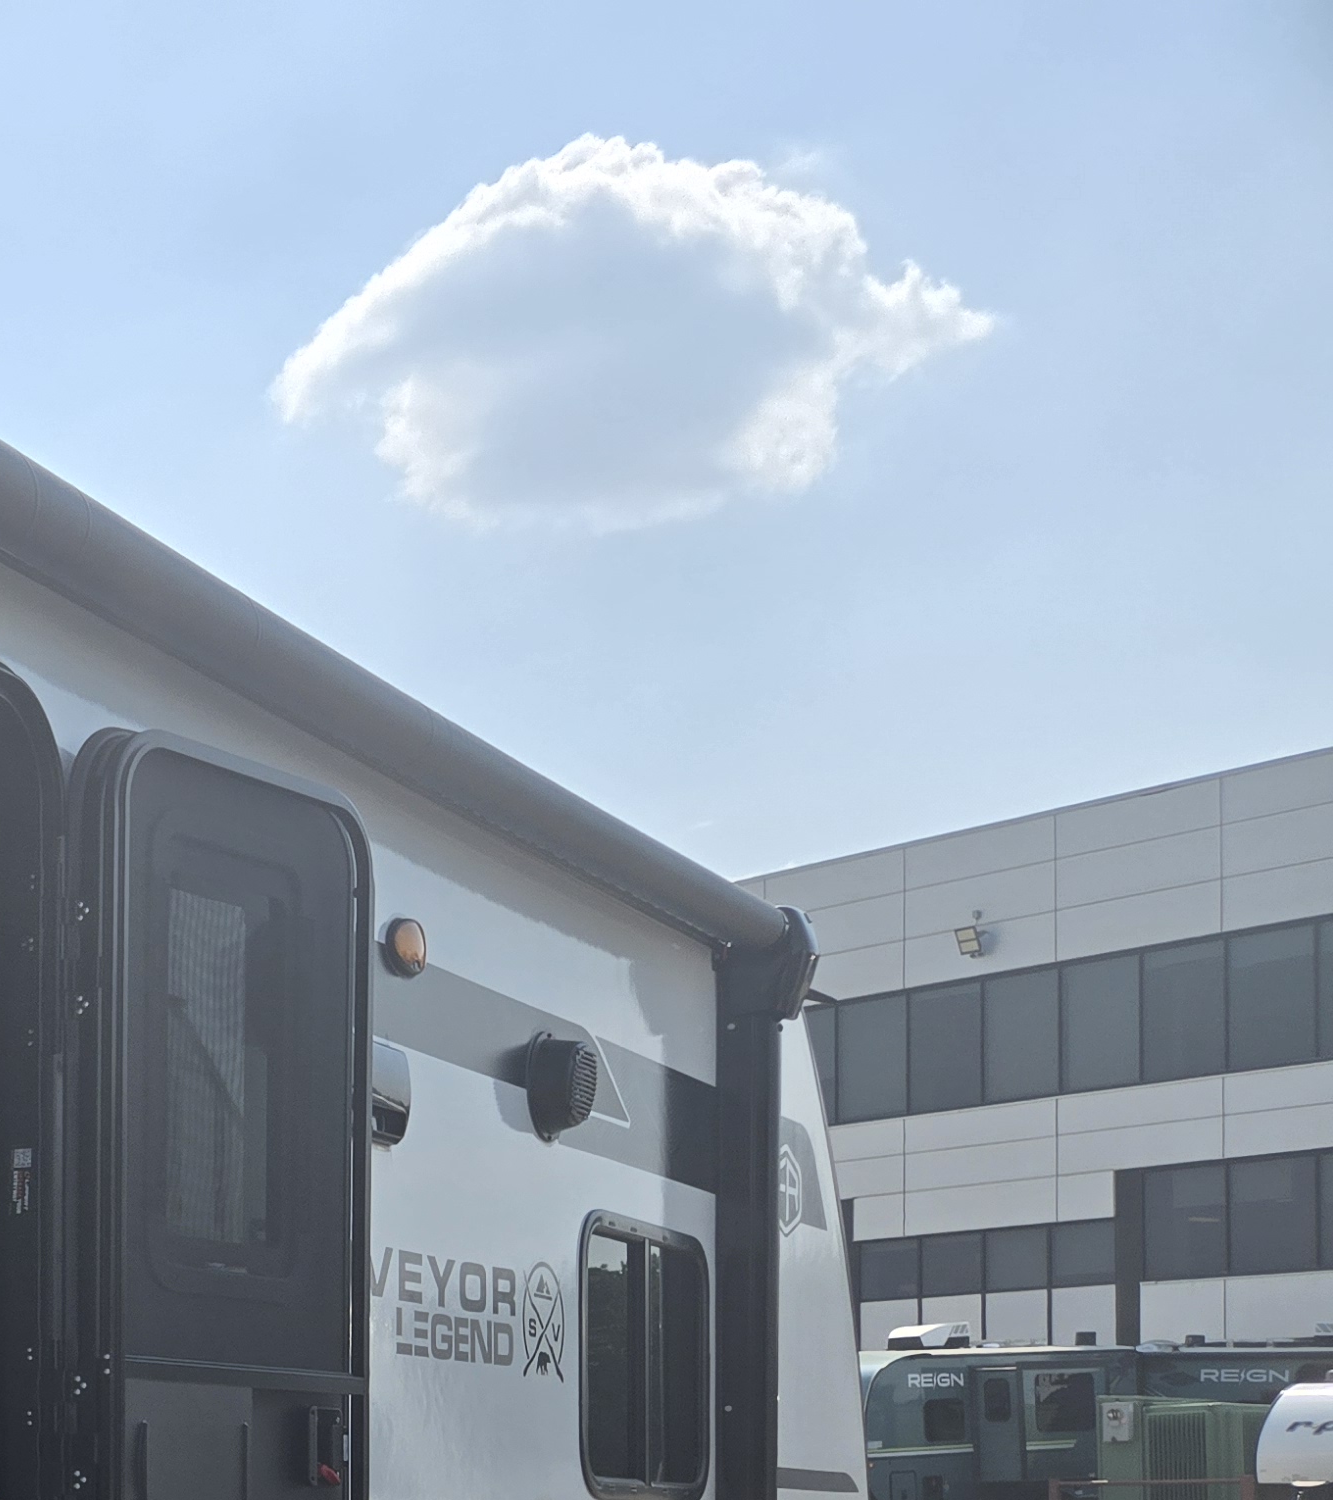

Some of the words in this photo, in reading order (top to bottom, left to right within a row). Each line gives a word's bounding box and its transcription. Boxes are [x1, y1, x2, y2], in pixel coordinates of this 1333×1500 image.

[396, 1306, 514, 1367] LEGEND
[528, 1318, 537, 1338] S
[551, 1322, 561, 1342] V
[907, 1372, 965, 1388] REIGN
[1200, 1367, 1290, 1384] REIGN
